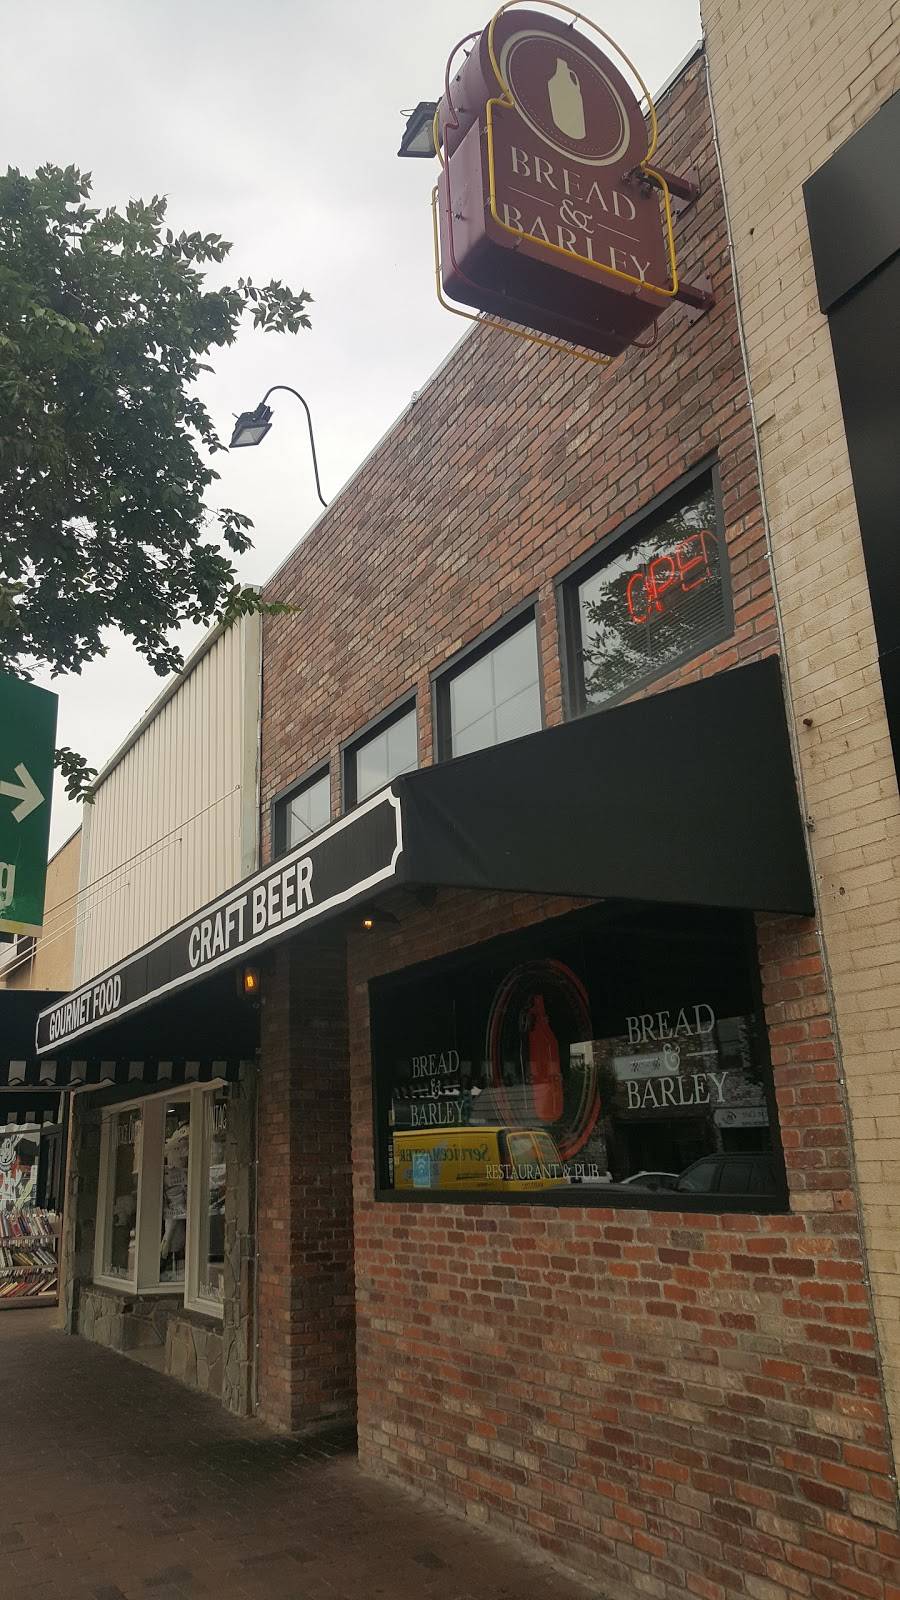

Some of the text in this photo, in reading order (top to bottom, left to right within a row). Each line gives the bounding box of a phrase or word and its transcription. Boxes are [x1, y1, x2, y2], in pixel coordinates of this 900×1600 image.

[510, 146, 636, 221] BREAD
[559, 199, 594, 234] &
[188, 857, 314, 968] CRAFT BEER
[49, 975, 121, 1041] GOURMET FOOD
[625, 1004, 715, 1044] BREAD
[412, 1050, 460, 1078] BREAD
[663, 1043, 680, 1071] &
[625, 1071, 729, 1109] BARLEY
[409, 1100, 464, 1127] BARLEY
[486, 1163, 600, 1180] RESTAURANT & PUB
